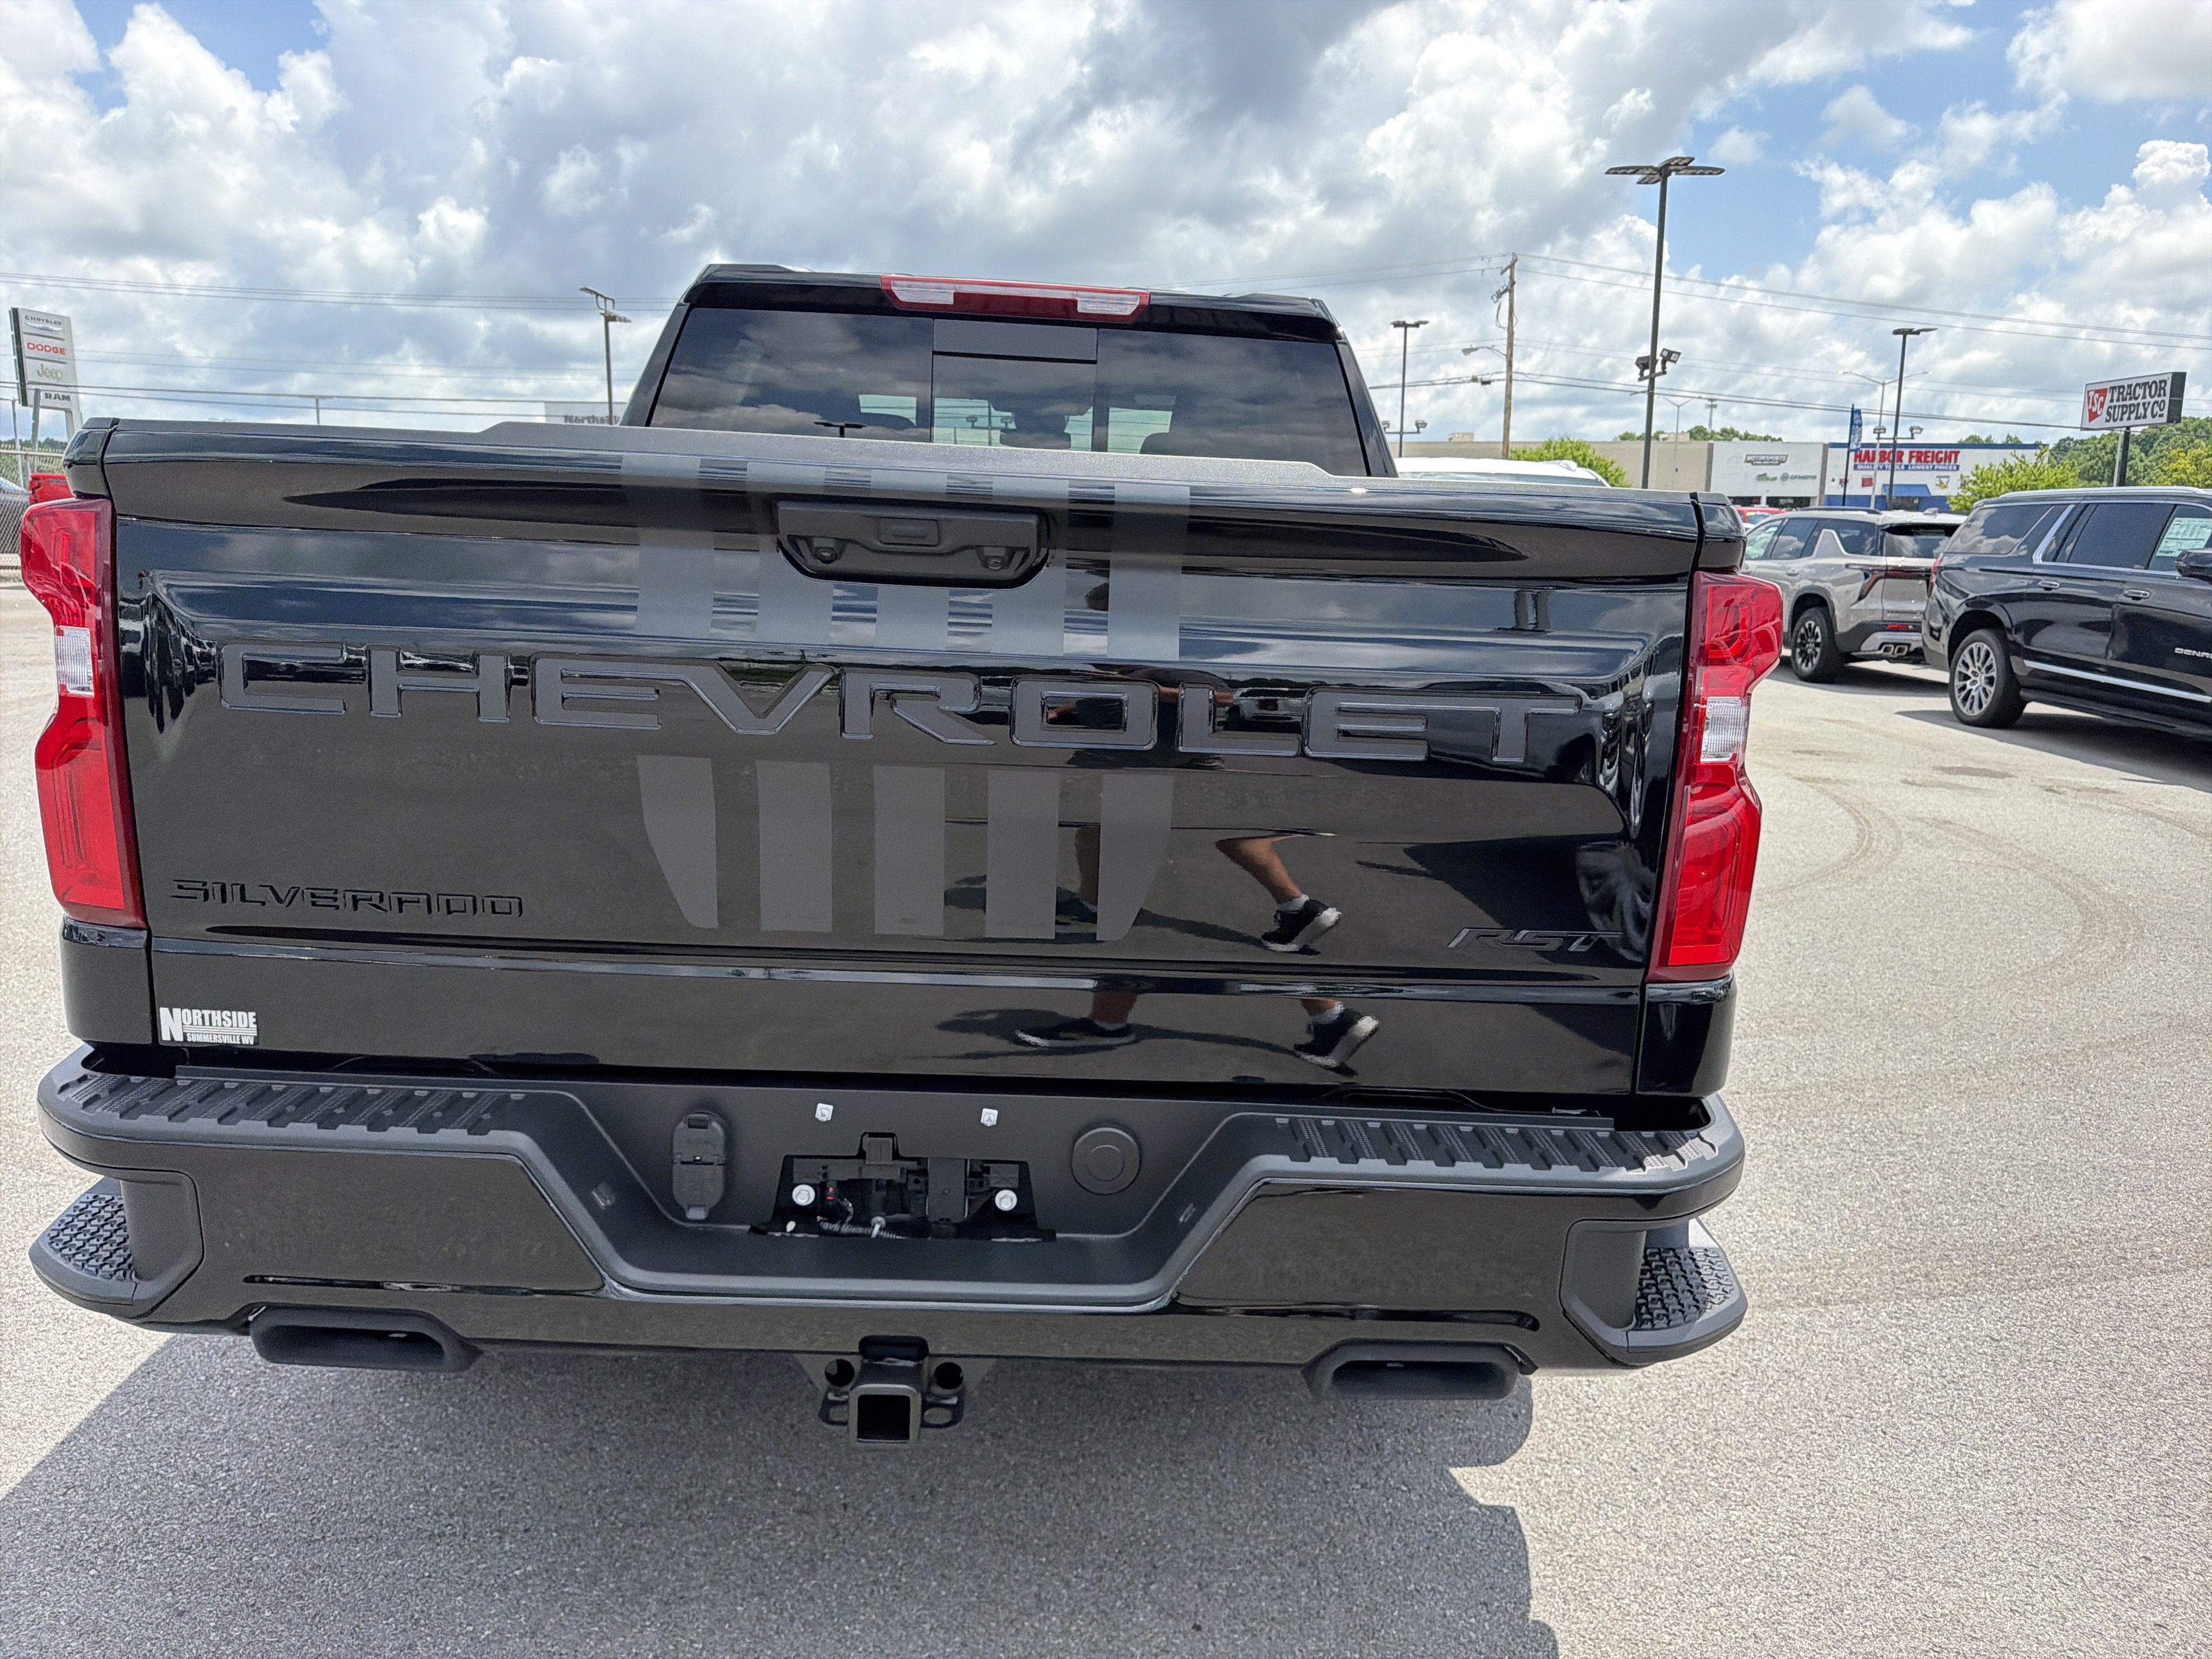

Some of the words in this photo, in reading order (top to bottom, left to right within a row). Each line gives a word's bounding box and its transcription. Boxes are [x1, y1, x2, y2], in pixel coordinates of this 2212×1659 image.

[25, 315, 62, 325] CHRYSLER
[27, 342, 66, 355] DODGE
[37, 364, 61, 382] Jeep
[44, 393, 71, 402] RAM
[2088, 391, 2104, 415] TSC
[2109, 380, 2168, 403] TRACTOR
[2104, 401, 2151, 424] SUPPLY
[1908, 450, 1961, 464] FREIGHT
[221, 642, 1582, 762] CHEVROLET
[171, 879, 522, 917] SILVERADO
[1447, 927, 1623, 952] RST
[159, 1007, 257, 1042] NORTHSIDE
[187, 1032, 241, 1045] SUMMERSVILLE
[241, 1035, 254, 1045] WV
